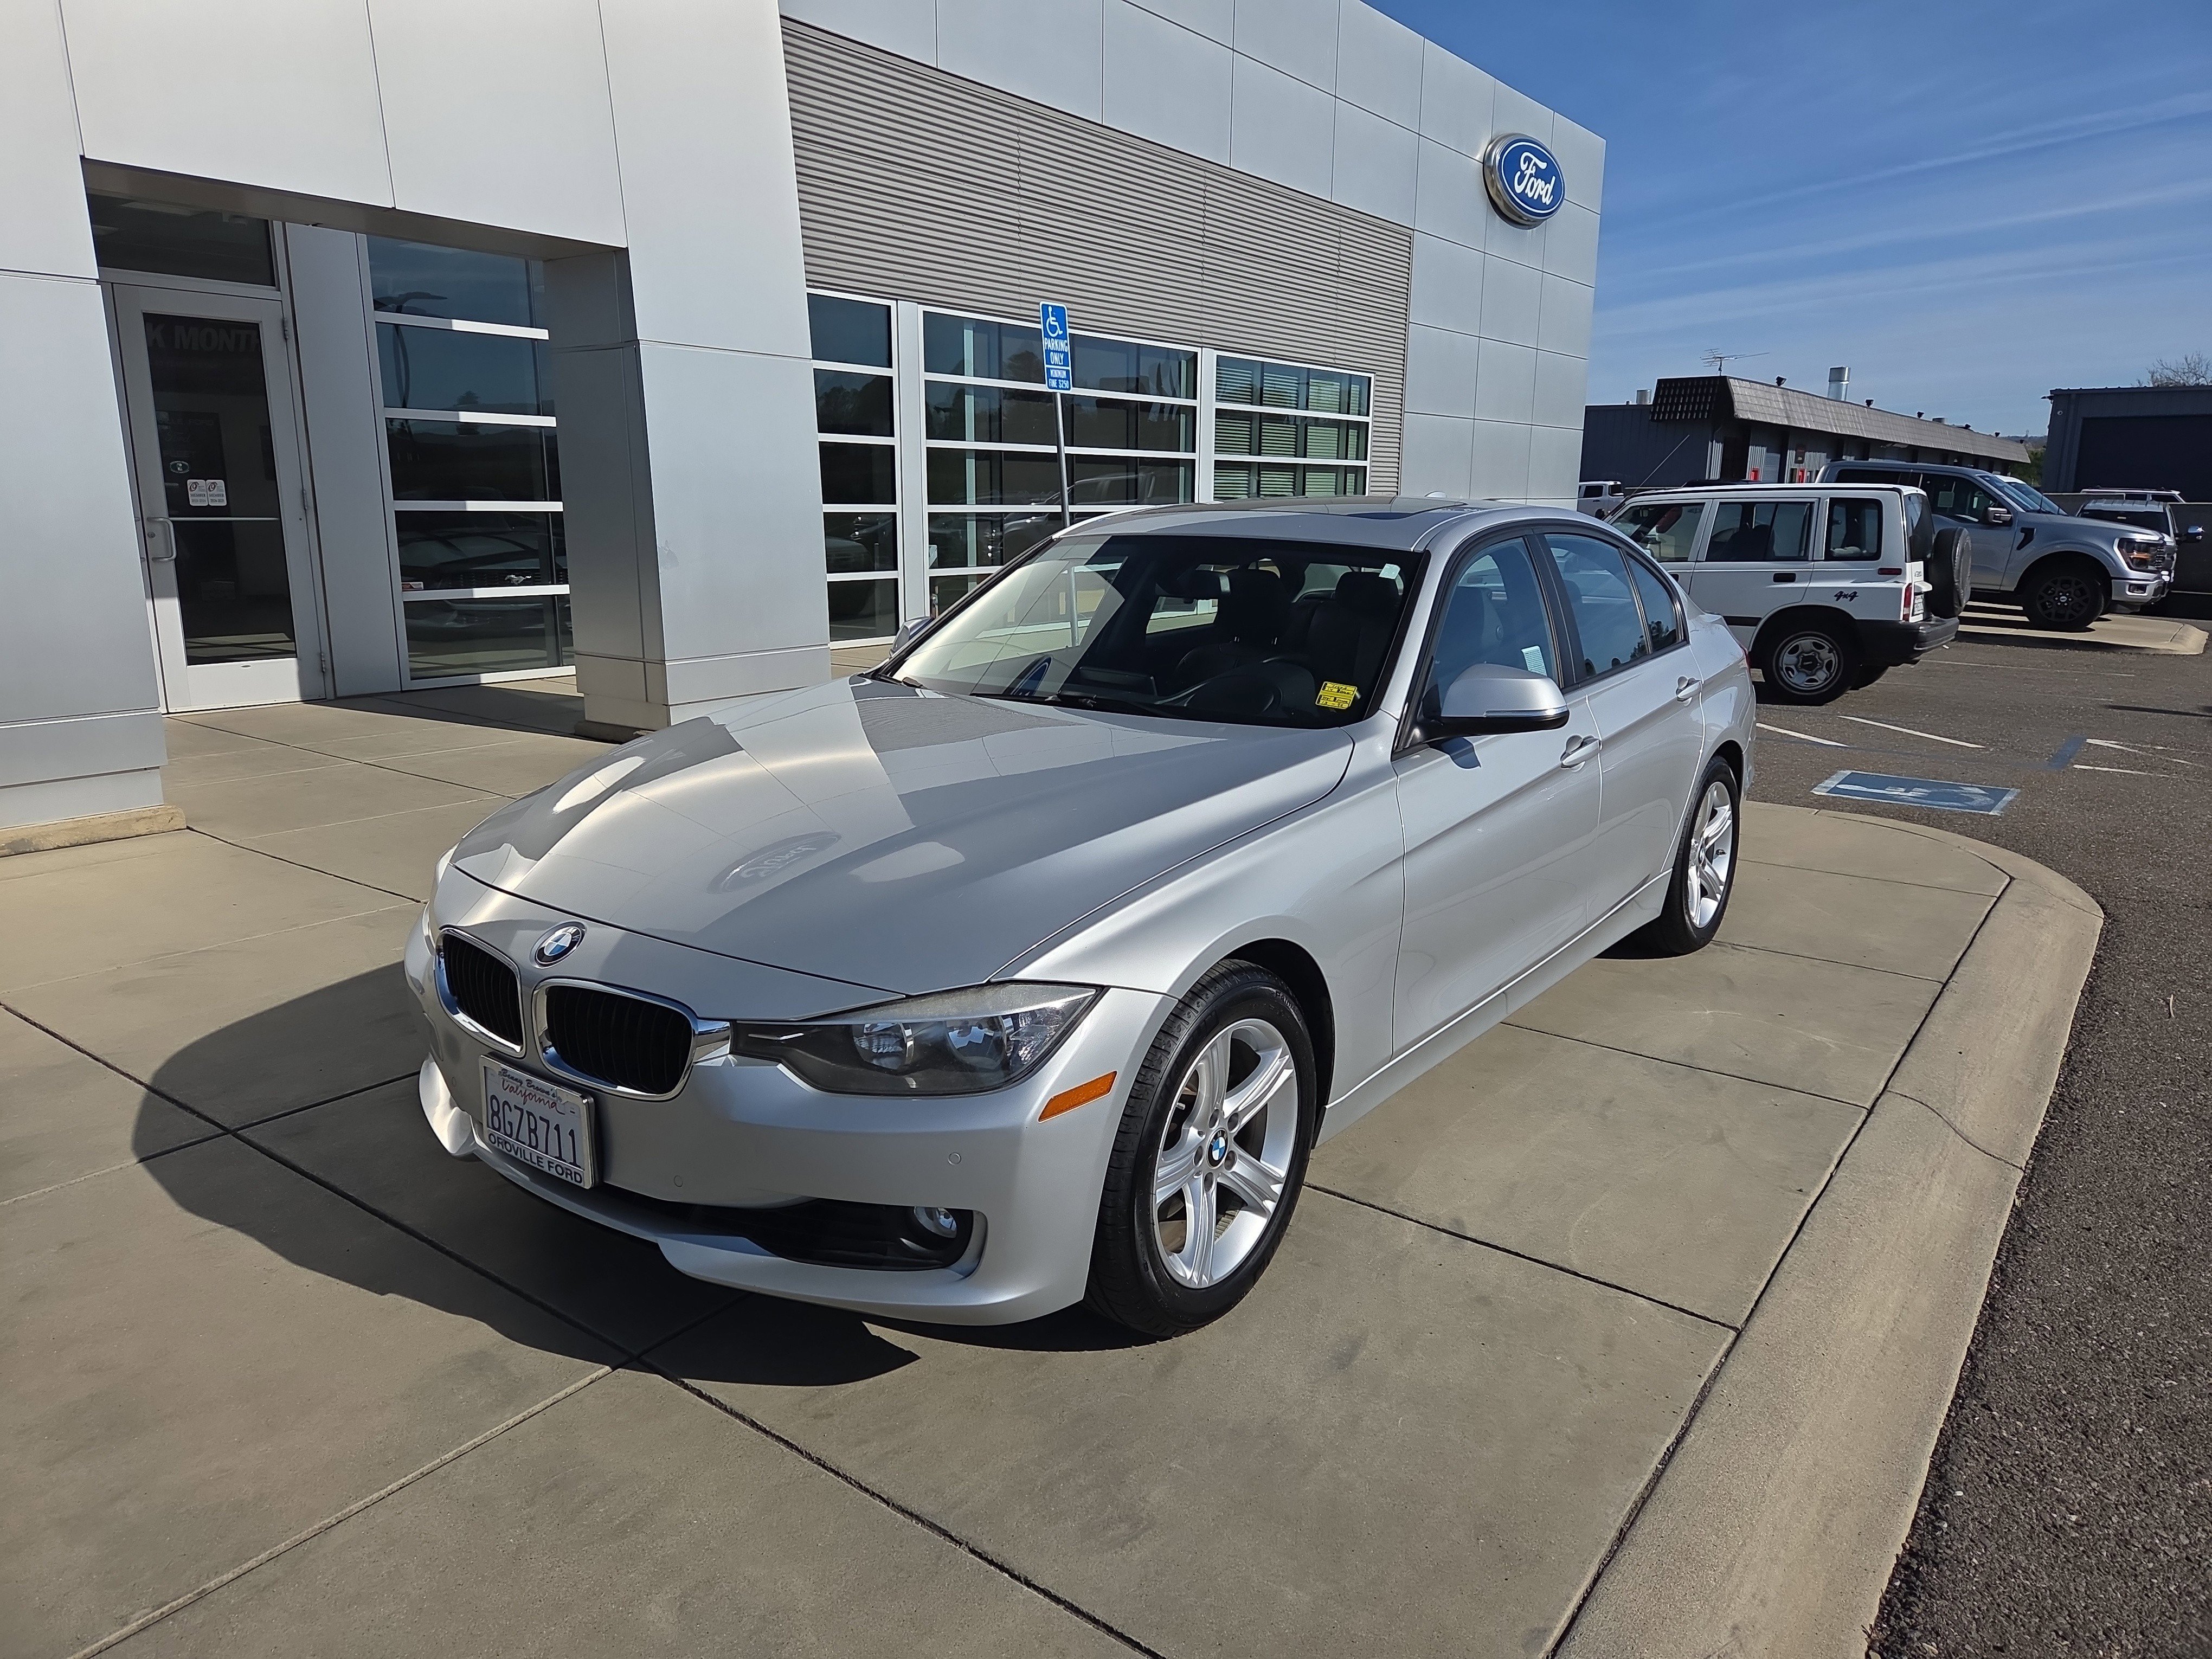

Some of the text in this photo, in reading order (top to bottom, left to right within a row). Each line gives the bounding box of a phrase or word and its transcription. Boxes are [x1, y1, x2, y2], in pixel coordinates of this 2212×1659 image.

[1514, 152, 1556, 205] Ford
[1044, 338, 1068, 352] PARKING
[1050, 351, 1064, 365] ONLY
[1049, 378, 1057, 388] FINE
[1834, 590, 1859, 602] 4x4
[490, 1094, 581, 1169] 8GZB711
[488, 1133, 583, 1185] OROVILLE FORD
